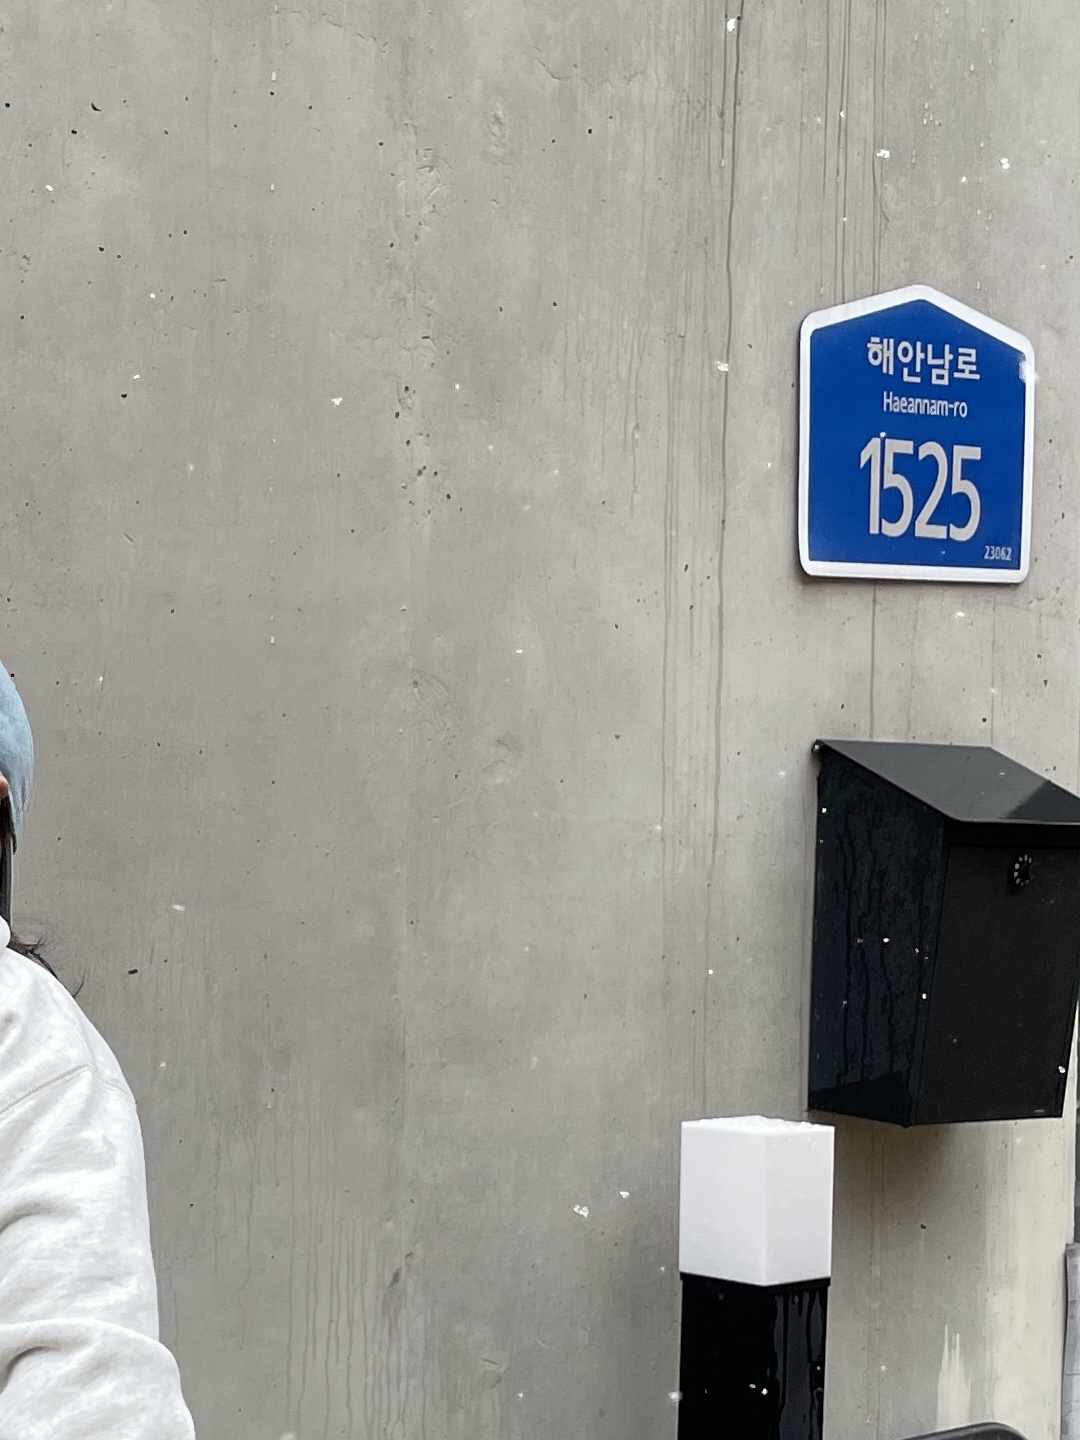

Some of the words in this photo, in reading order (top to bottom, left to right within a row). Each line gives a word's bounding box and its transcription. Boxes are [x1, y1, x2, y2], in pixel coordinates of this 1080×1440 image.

[866, 336, 980, 386] 해안남로
[883, 391, 968, 418] Haeannam-ro
[859, 437, 982, 541] 1525
